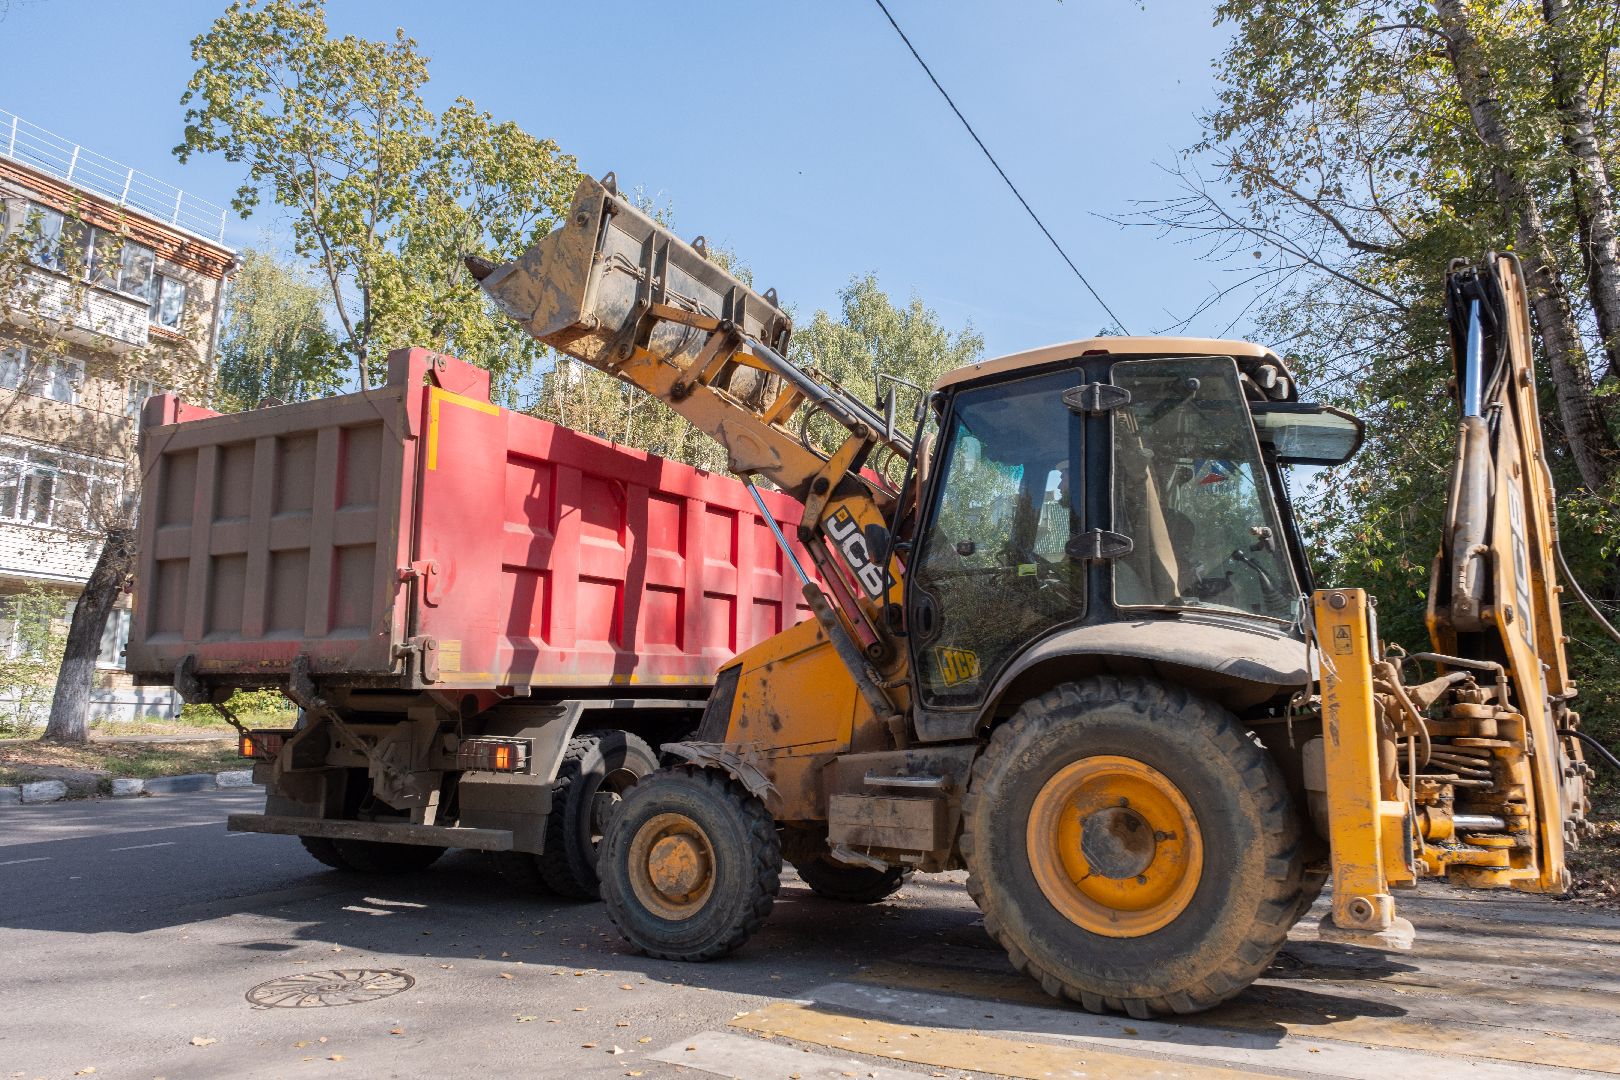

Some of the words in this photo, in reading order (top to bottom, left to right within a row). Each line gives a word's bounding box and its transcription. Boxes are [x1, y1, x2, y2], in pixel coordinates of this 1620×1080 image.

[827, 517, 892, 597] JCB
[1507, 479, 1534, 648] JCB
[943, 650, 978, 683] JCB
